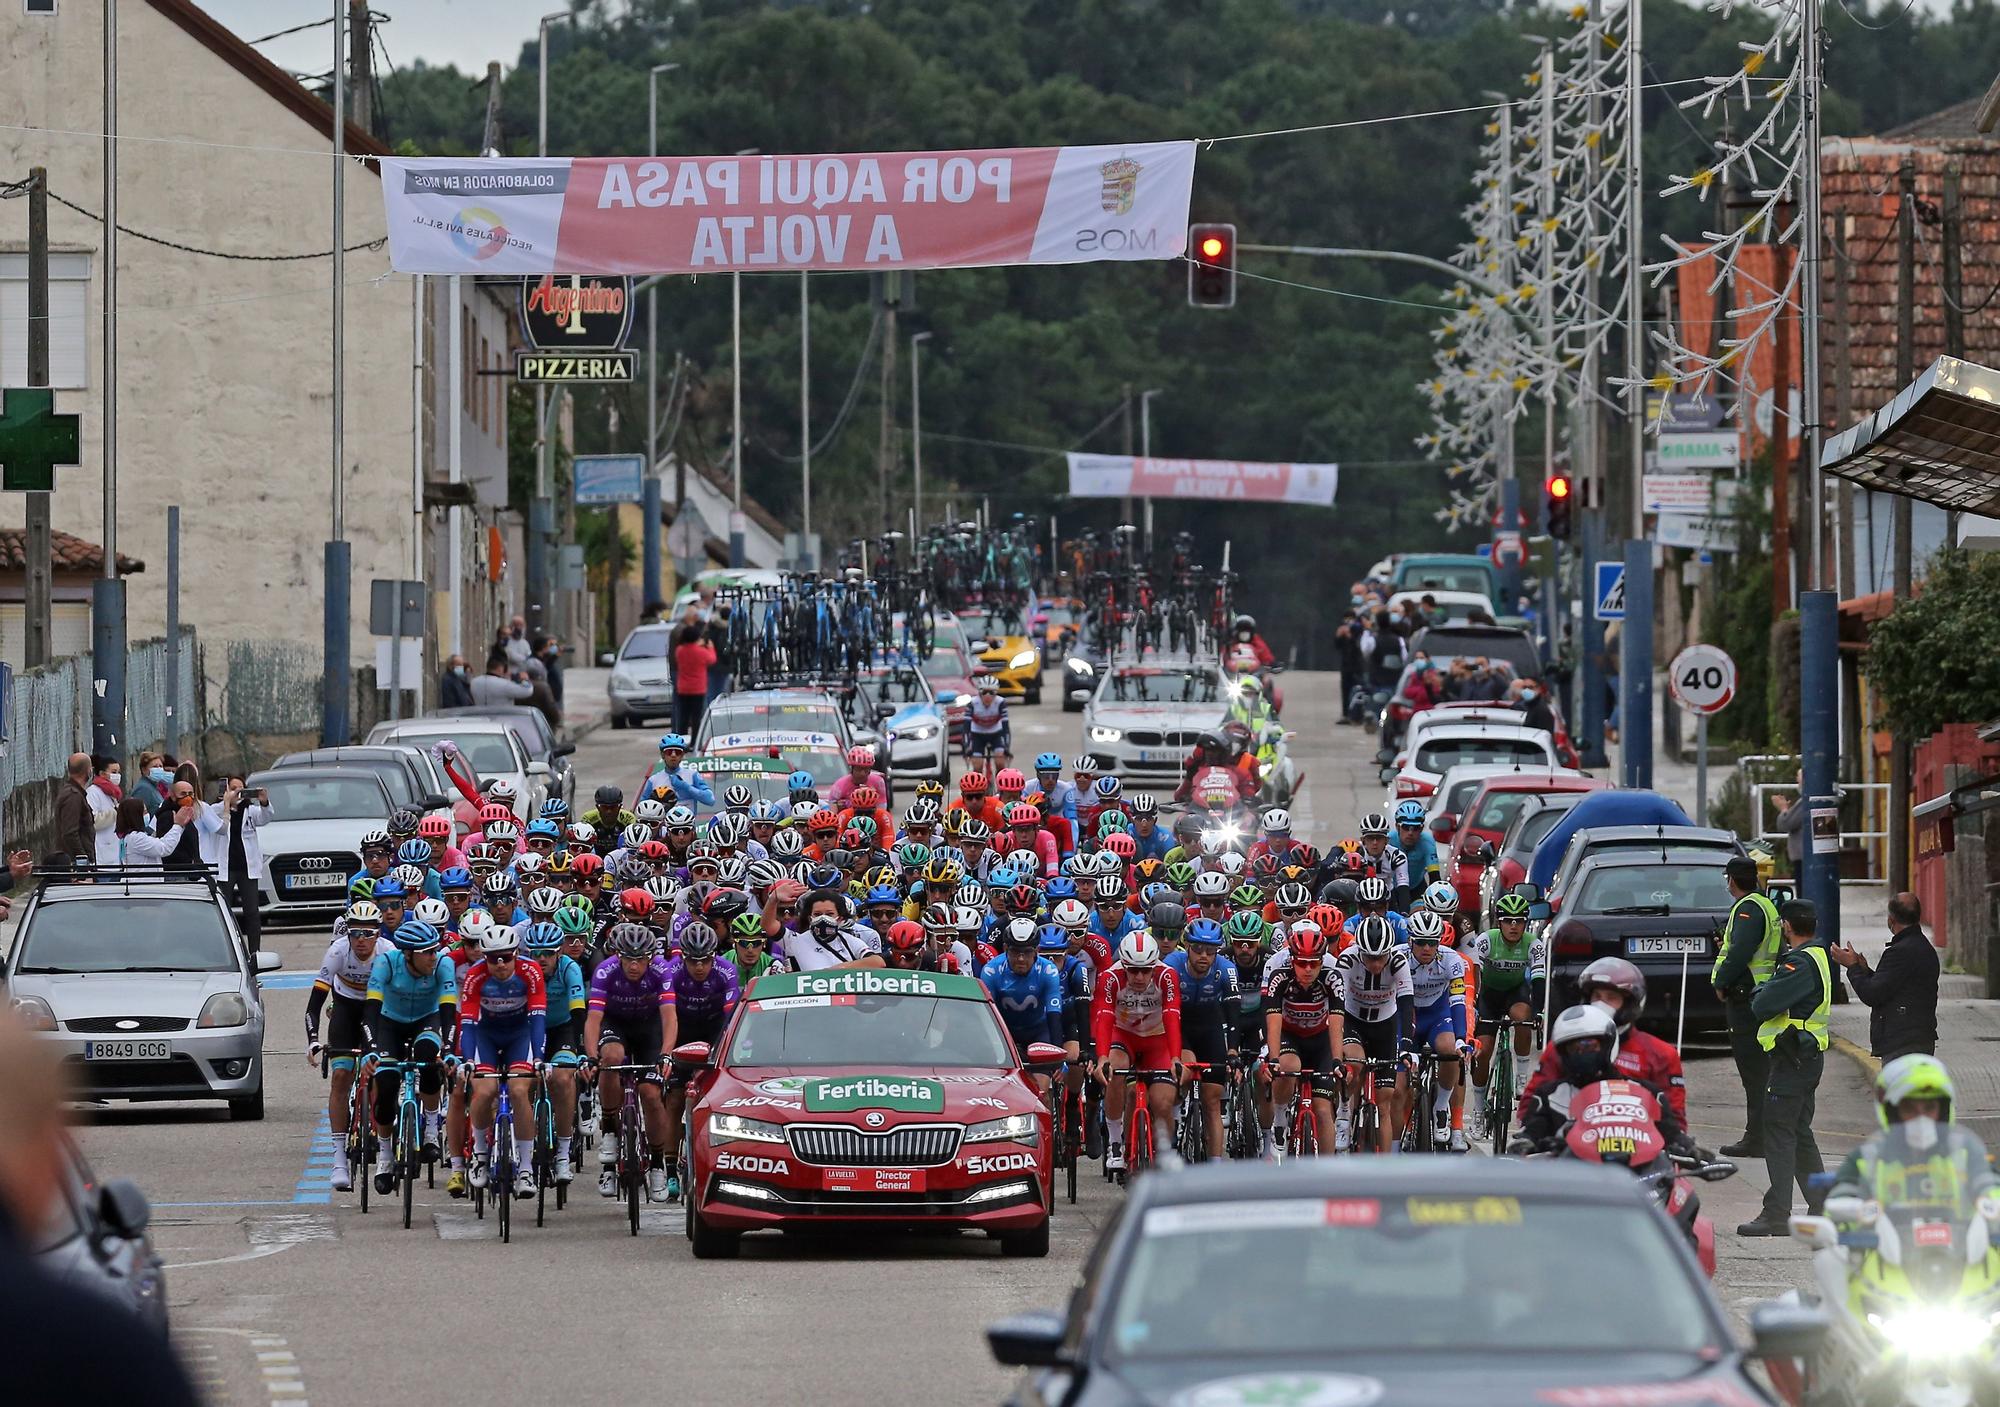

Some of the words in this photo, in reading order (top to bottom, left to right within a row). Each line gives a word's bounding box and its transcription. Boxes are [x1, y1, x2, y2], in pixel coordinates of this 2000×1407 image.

[523, 358, 628, 379] PIZZERIA
[1681, 666, 1723, 690] 40
[747, 733, 799, 744] Carrefour
[292, 875, 320, 886] 7816
[1640, 939, 1670, 951] 1751
[796, 972, 937, 994] Fertiberia
[1163, 973, 1174, 1002] Cofidis
[1226, 967, 1240, 992] BMC
[1267, 972, 1289, 998] SOUDAL
[96, 1043, 133, 1057] 8849
[138, 1043, 166, 1057] GCG
[818, 1077, 932, 1102] Fertiberia
[1597, 1126, 1651, 1144] YAMAHA
[1597, 1138, 1636, 1153] META
[716, 1152, 790, 1175] ŠKODA
[967, 1153, 1038, 1175] ŠKODA
[875, 1170, 912, 1180] Director
[875, 1180, 911, 1190] General
